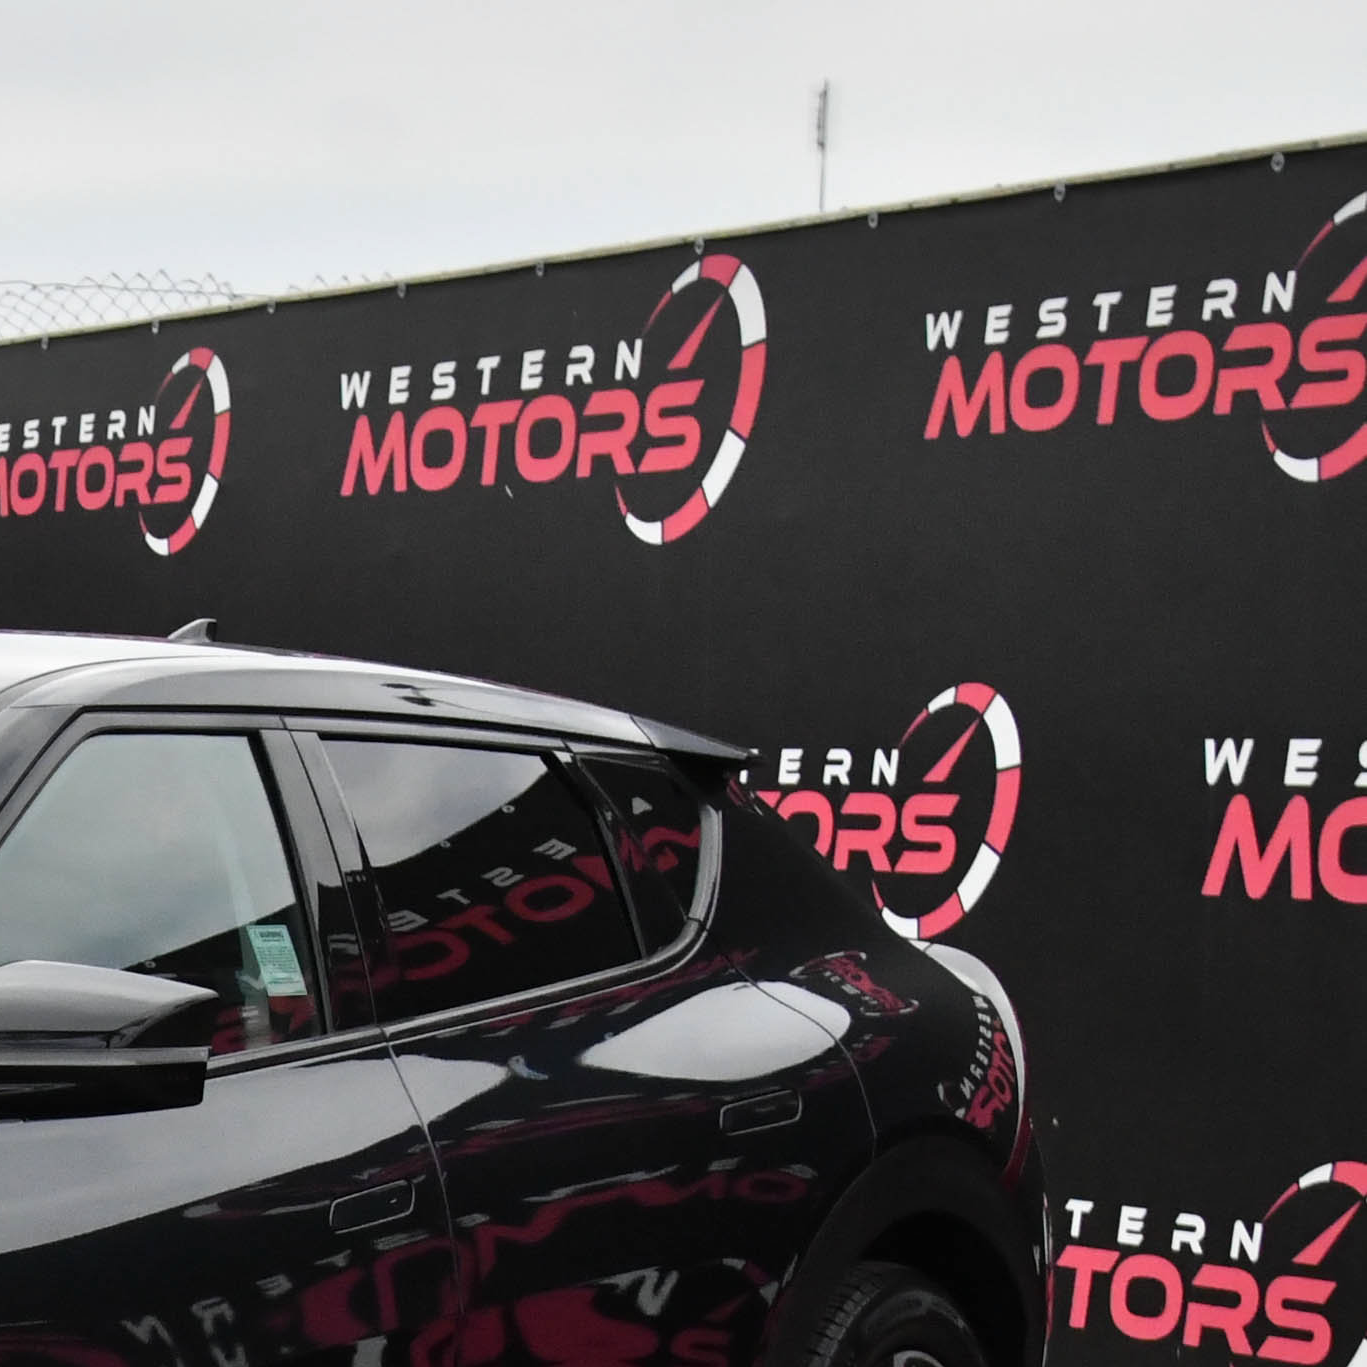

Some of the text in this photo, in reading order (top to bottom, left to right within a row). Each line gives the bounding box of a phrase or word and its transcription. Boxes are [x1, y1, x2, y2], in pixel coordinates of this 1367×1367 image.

[925, 270, 1297, 351] WESTERN
[340, 338, 644, 411] WESTERN
[923, 313, 1367, 440] MOTORS
[339, 378, 706, 497] MOTORS
[739, 748, 899, 787] ERN
[755, 790, 960, 875] ORS
[1065, 1198, 1264, 1264] TERN
[1056, 1244, 1338, 1365] TORS
